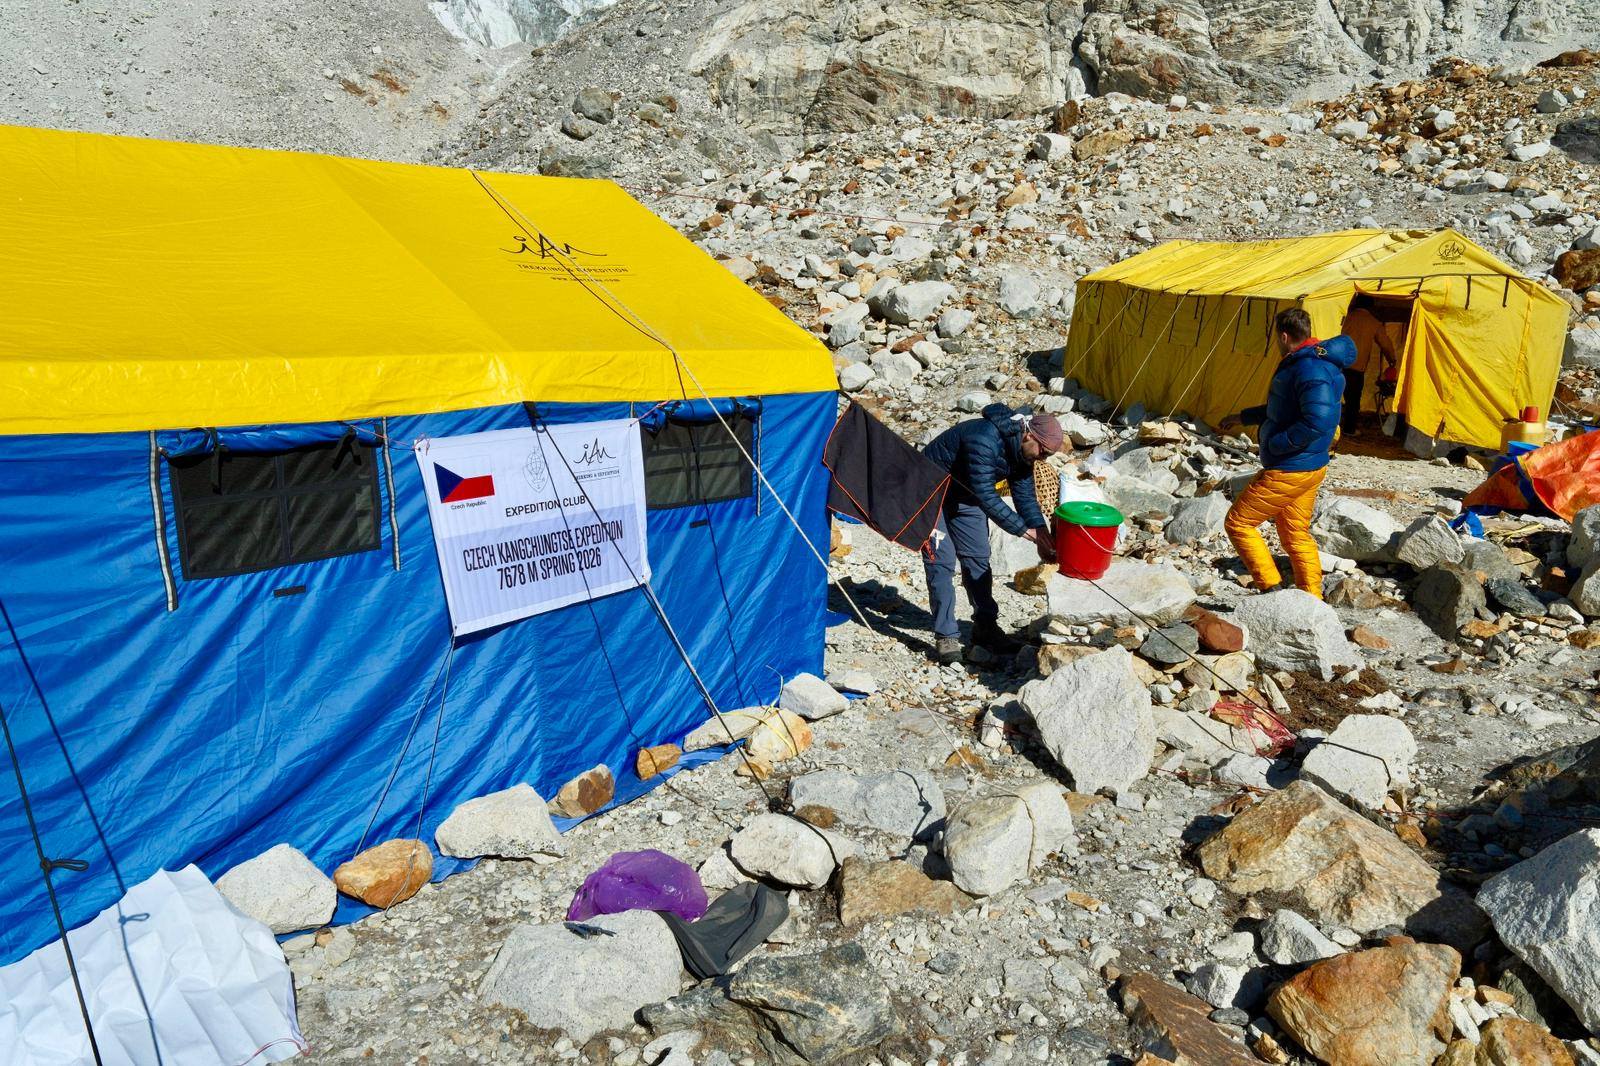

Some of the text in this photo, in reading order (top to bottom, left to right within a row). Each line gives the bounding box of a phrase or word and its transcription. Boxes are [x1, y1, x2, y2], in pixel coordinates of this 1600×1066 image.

[466, 500, 487, 508] Republic
[505, 495, 586, 517] EXPEDITION CLUB
[463, 520, 624, 572] CZECH KANGCHUNGTSE EXPEDITION
[497, 546, 602, 590] 7678 M SPRING 2026
